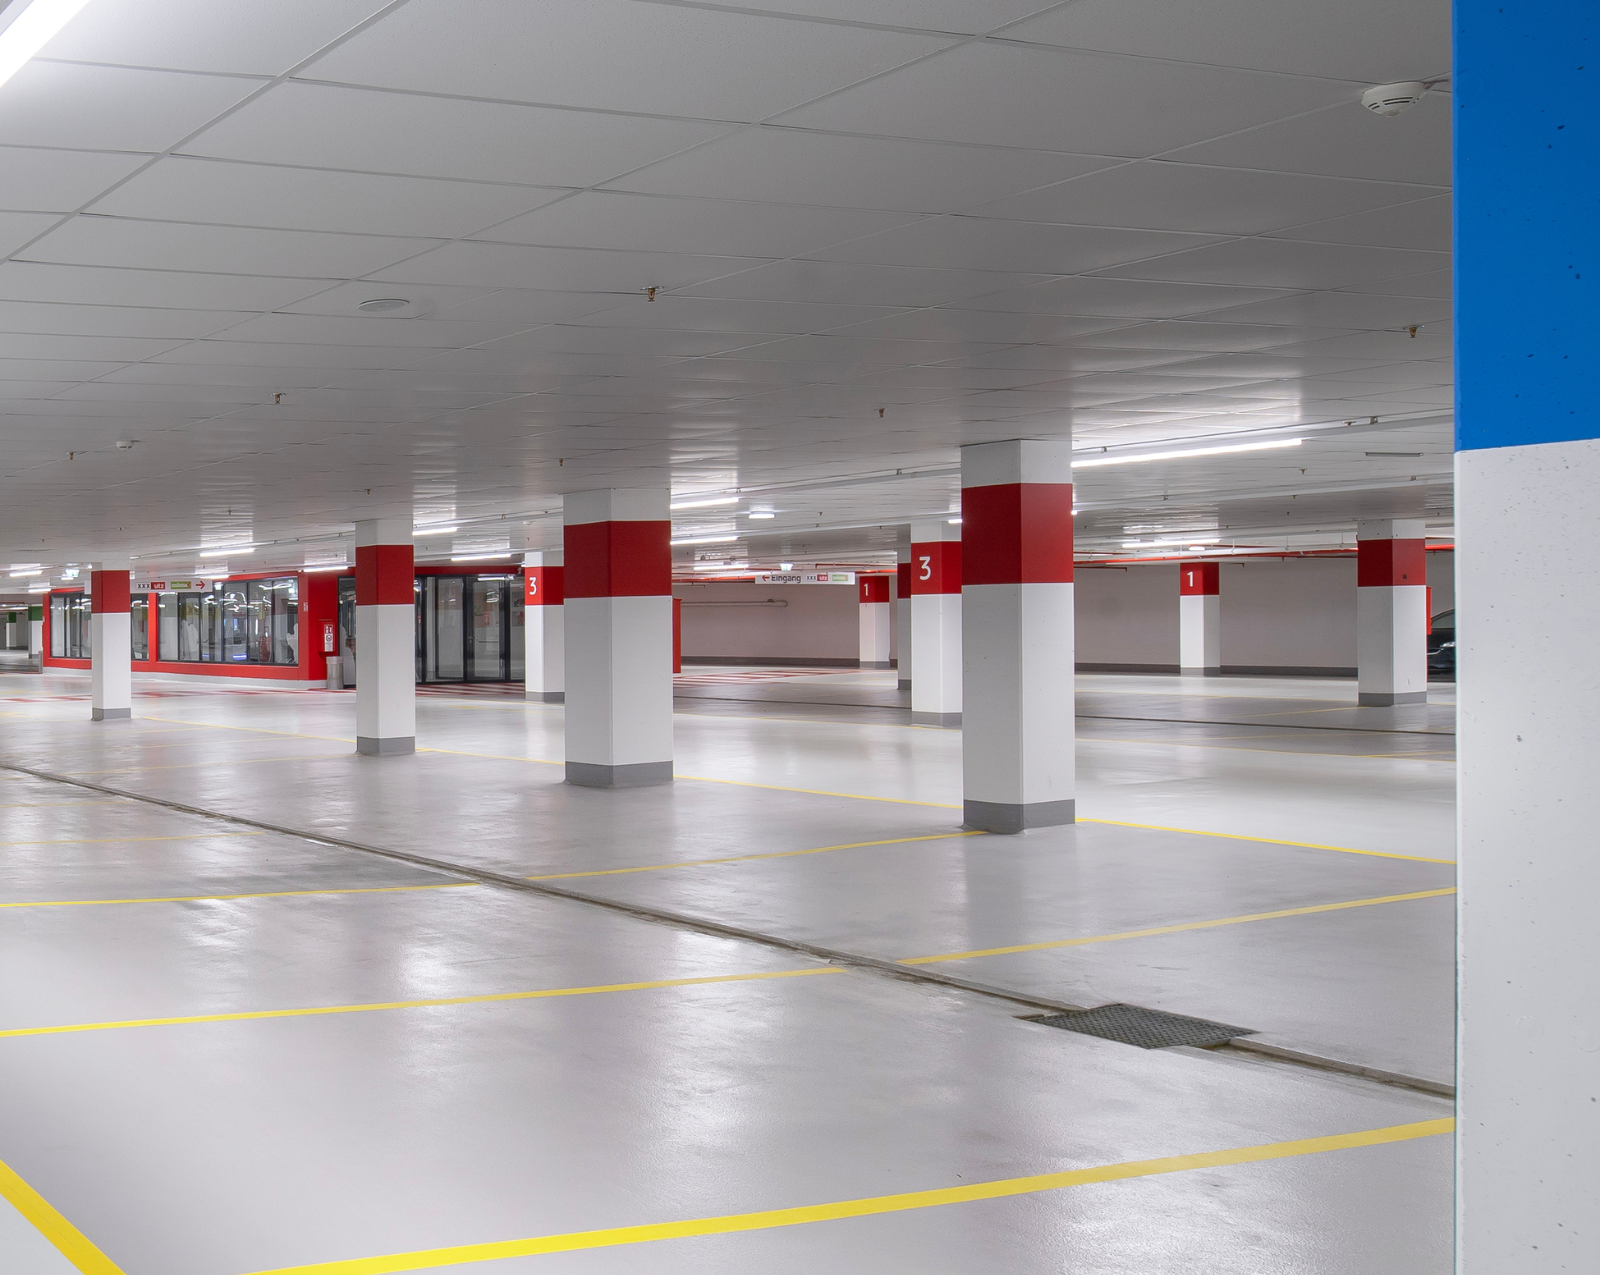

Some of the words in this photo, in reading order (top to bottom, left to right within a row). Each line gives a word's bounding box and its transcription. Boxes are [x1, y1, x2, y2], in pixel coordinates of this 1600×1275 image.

[919, 556, 931, 580] 3
[529, 576, 537, 595] 3
[771, 574, 802, 583] Eingang
[1186, 571, 1194, 587] 1
[863, 583, 869, 597] 1
